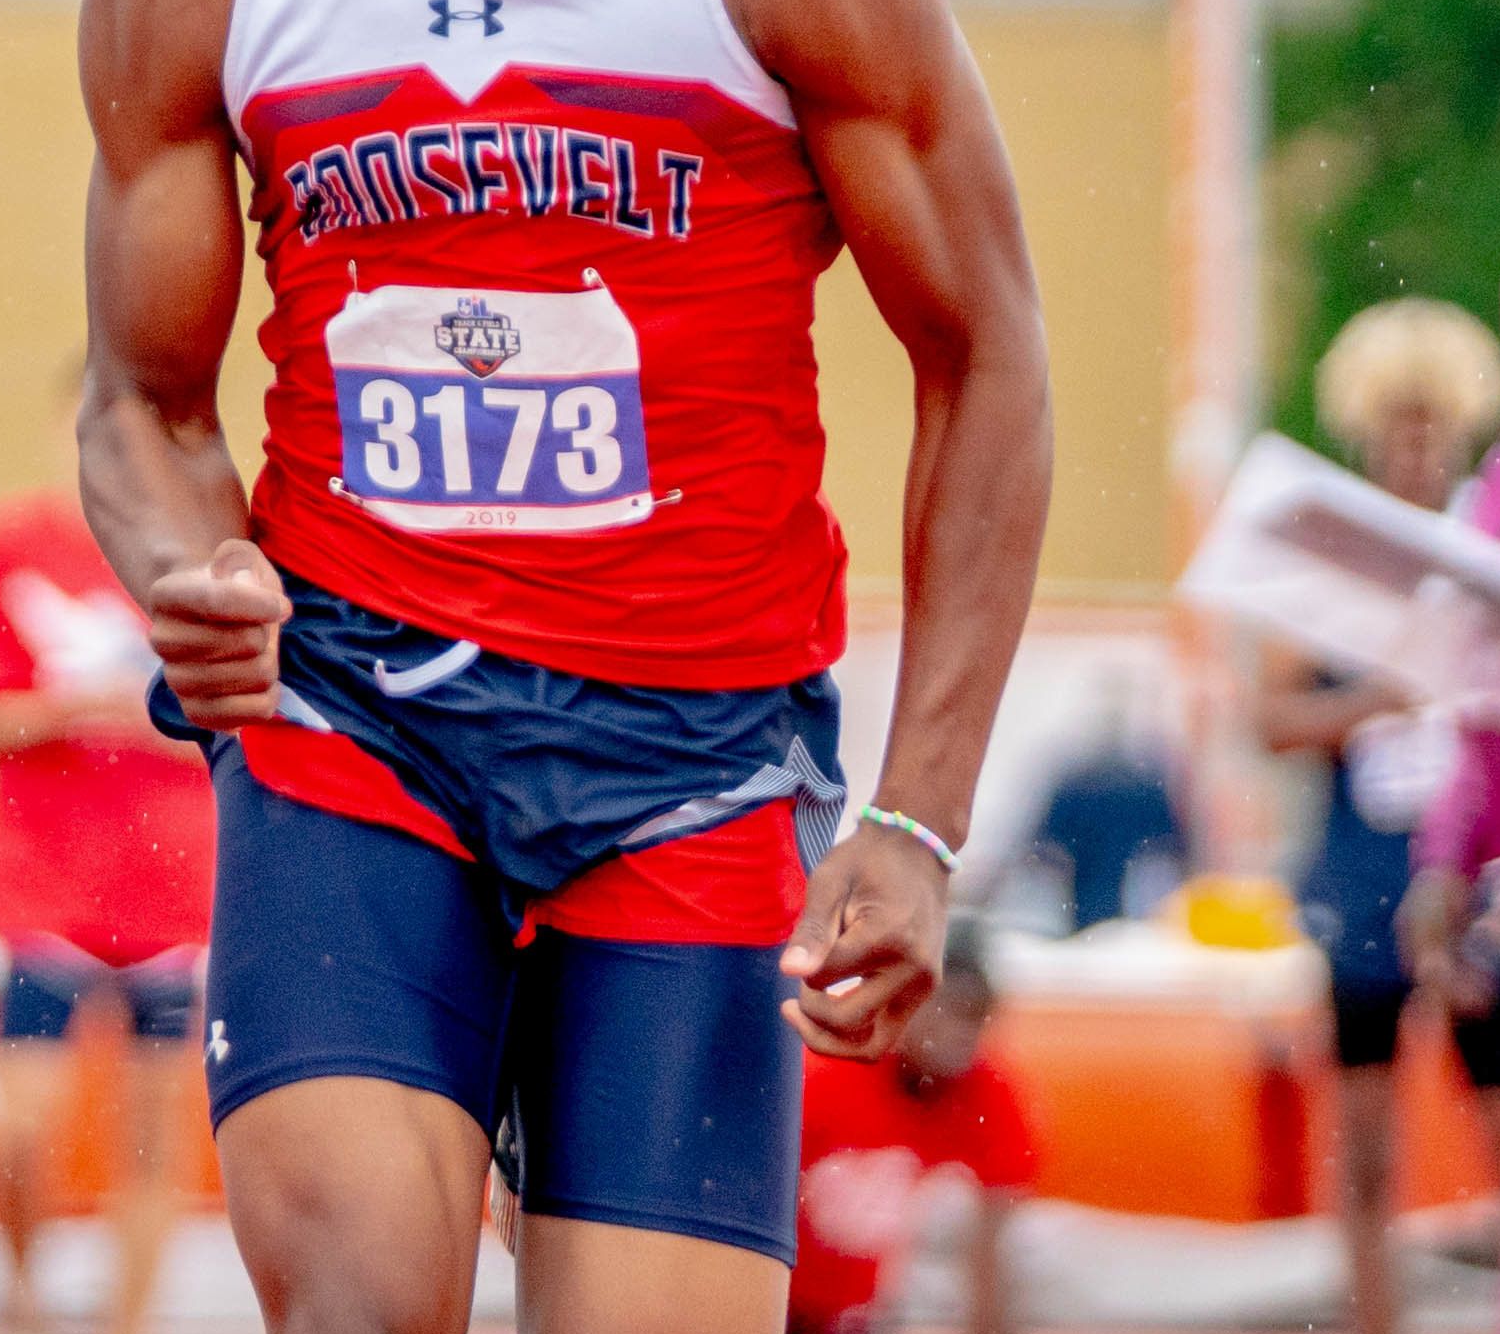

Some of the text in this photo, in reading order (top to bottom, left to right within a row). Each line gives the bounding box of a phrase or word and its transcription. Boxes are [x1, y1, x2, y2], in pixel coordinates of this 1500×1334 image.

[436, 326, 519, 352] STATE
[360, 378, 623, 494] 3173
[465, 511, 517, 526] 2019
